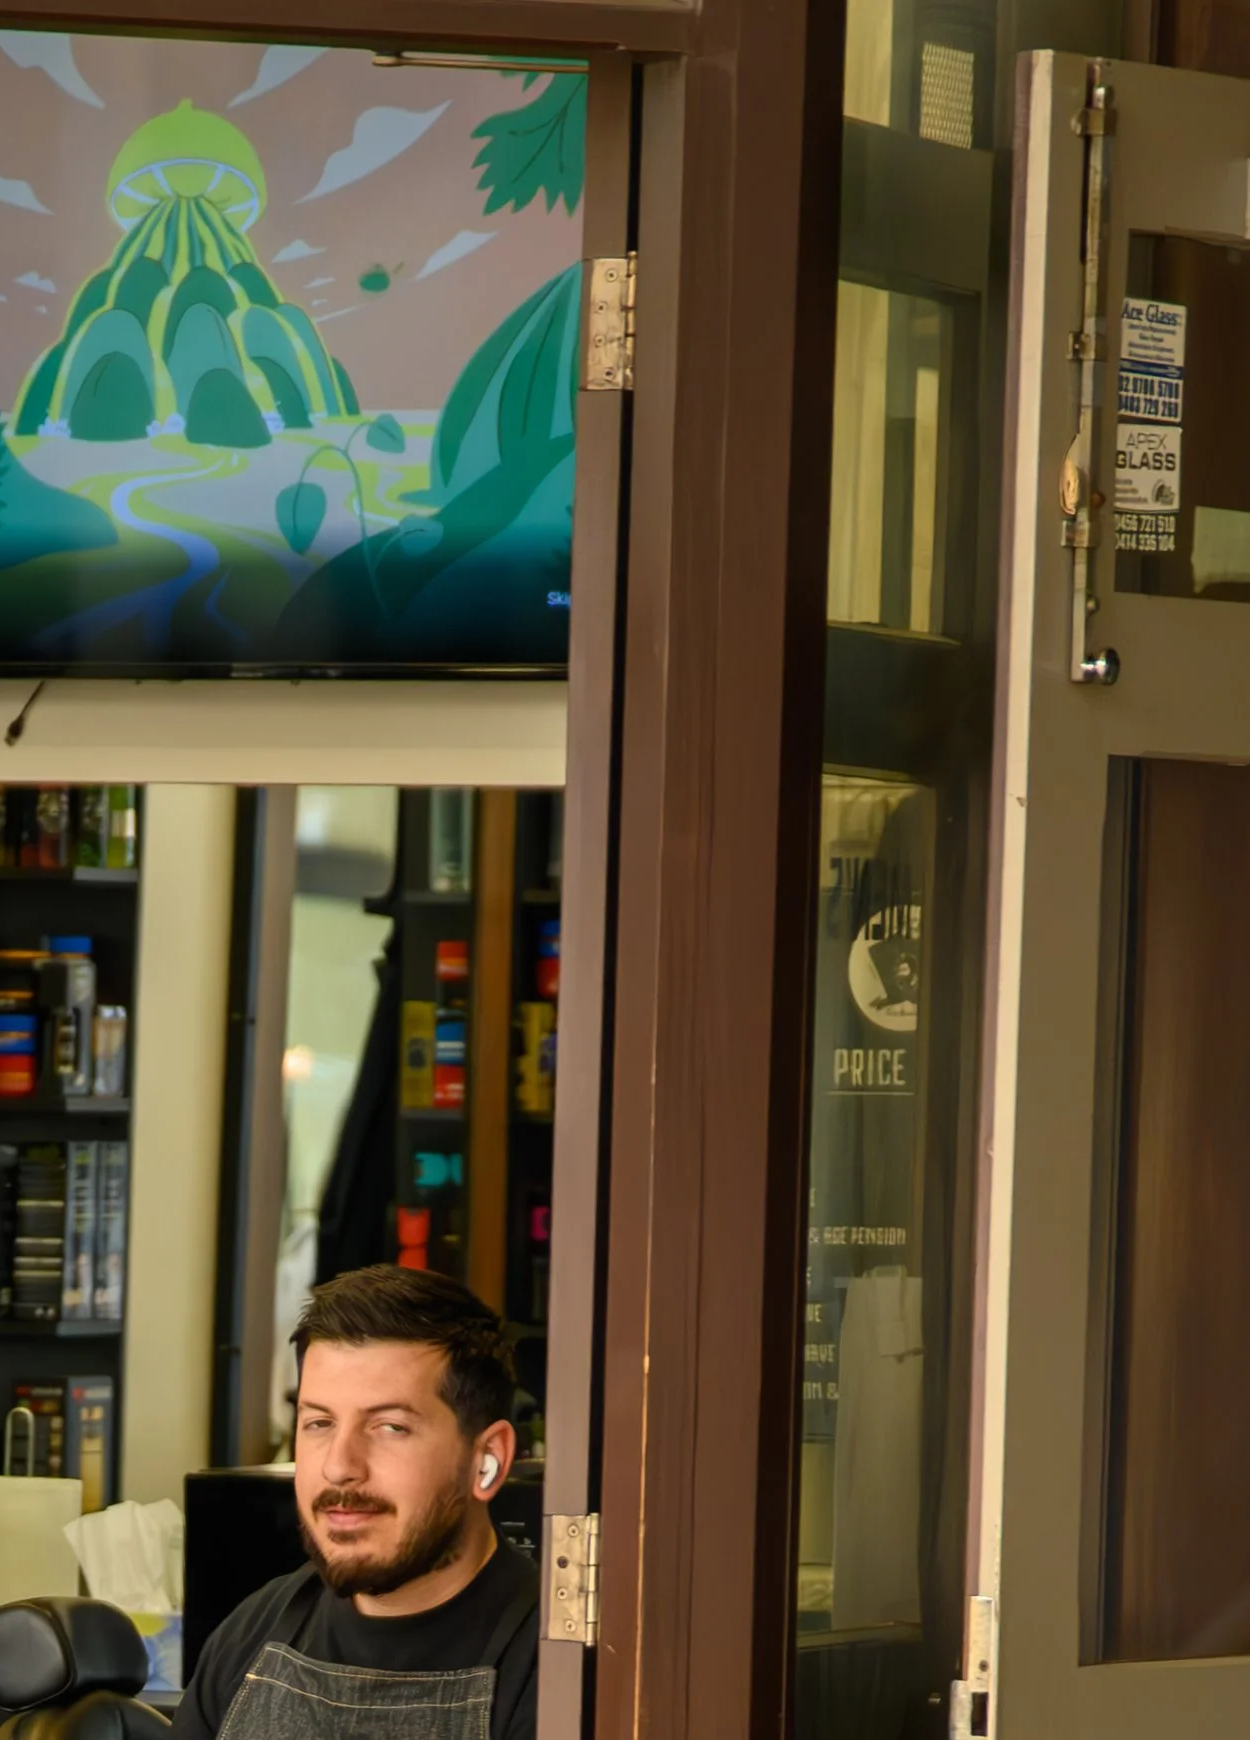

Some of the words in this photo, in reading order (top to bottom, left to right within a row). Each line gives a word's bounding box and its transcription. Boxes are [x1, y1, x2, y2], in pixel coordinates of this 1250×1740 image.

[1121, 301, 1144, 321] Ace
[1125, 432, 1168, 450] APEX
[1115, 450, 1176, 471] GLASS
[834, 1048, 908, 1086] PRICE
[851, 1226, 906, 1246] PENSION
